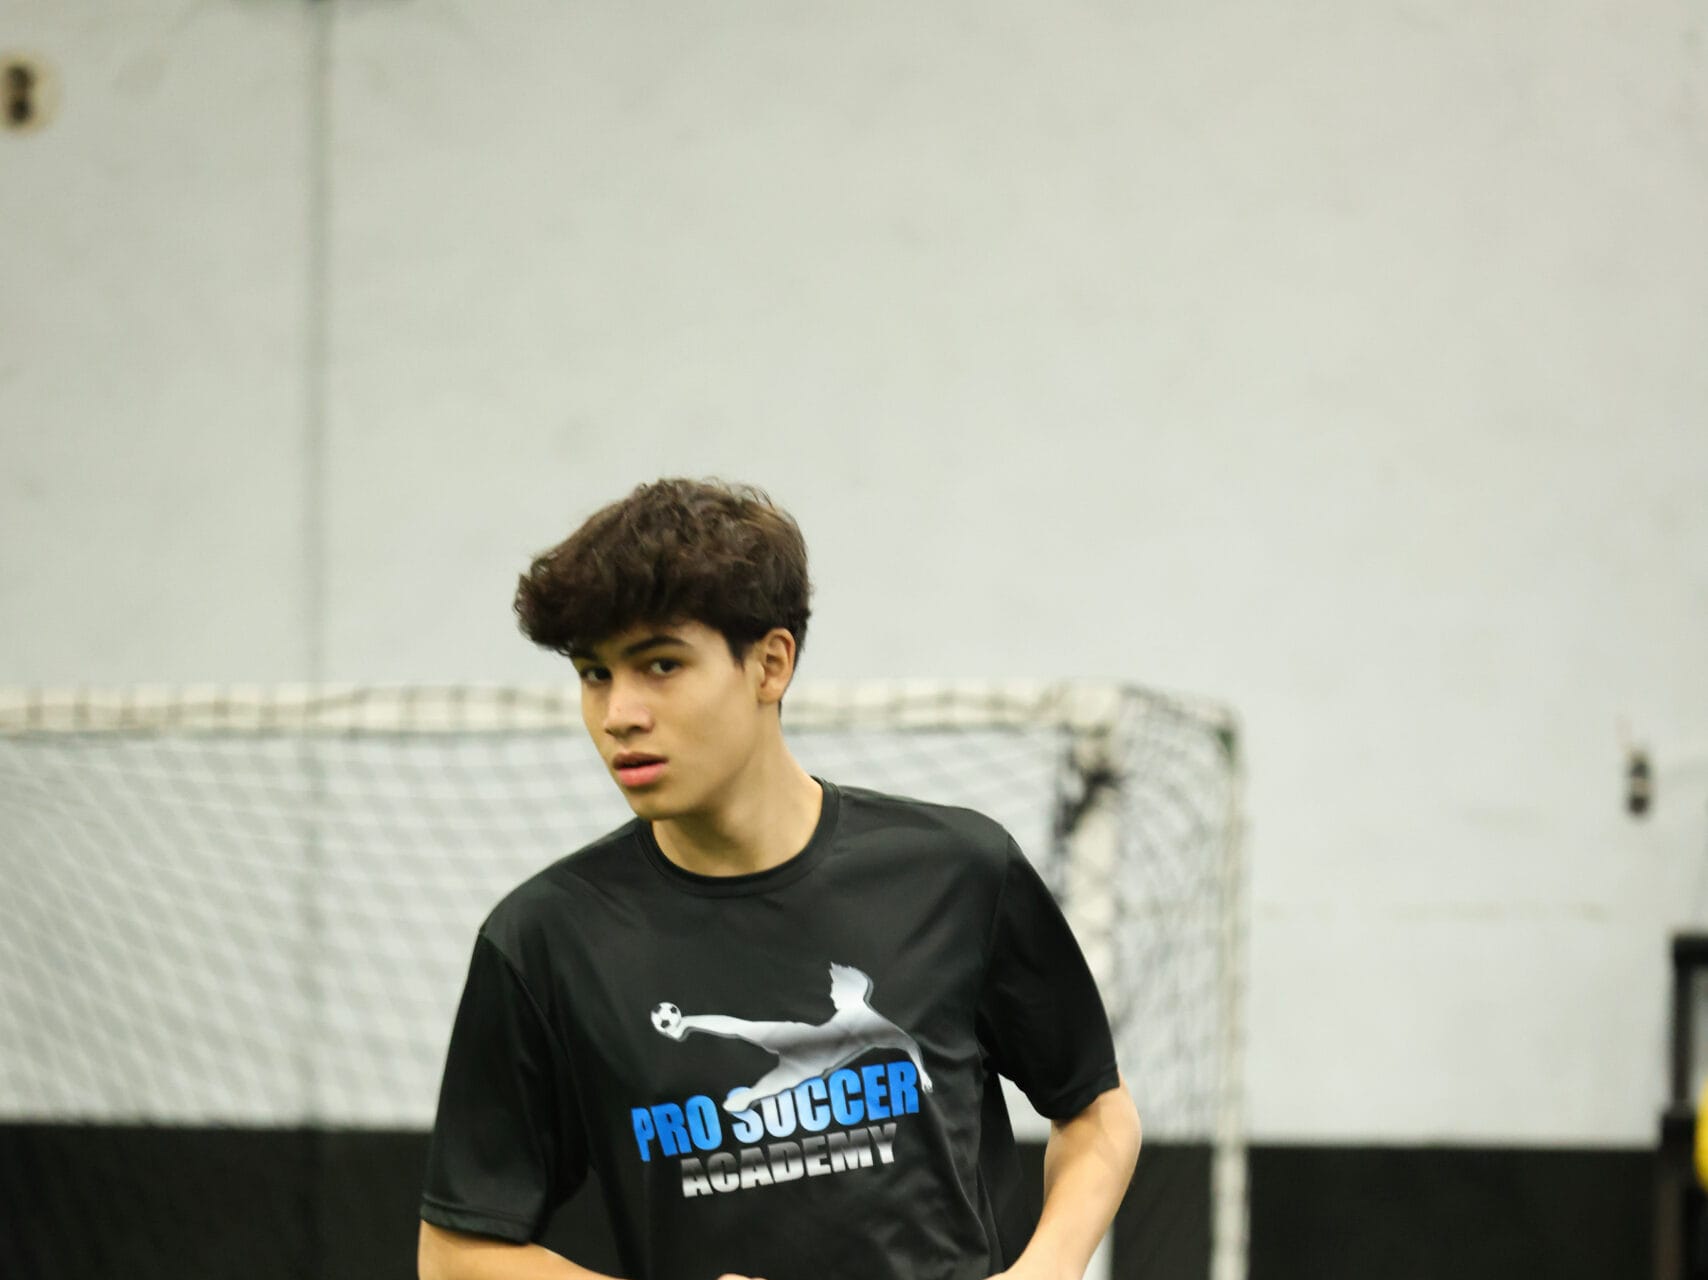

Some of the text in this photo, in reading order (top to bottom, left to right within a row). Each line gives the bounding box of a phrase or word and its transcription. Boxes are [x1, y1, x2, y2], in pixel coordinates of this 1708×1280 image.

[630, 1061, 920, 1162] PRO SOCCER
[680, 1122, 897, 1198] ACADEMY
